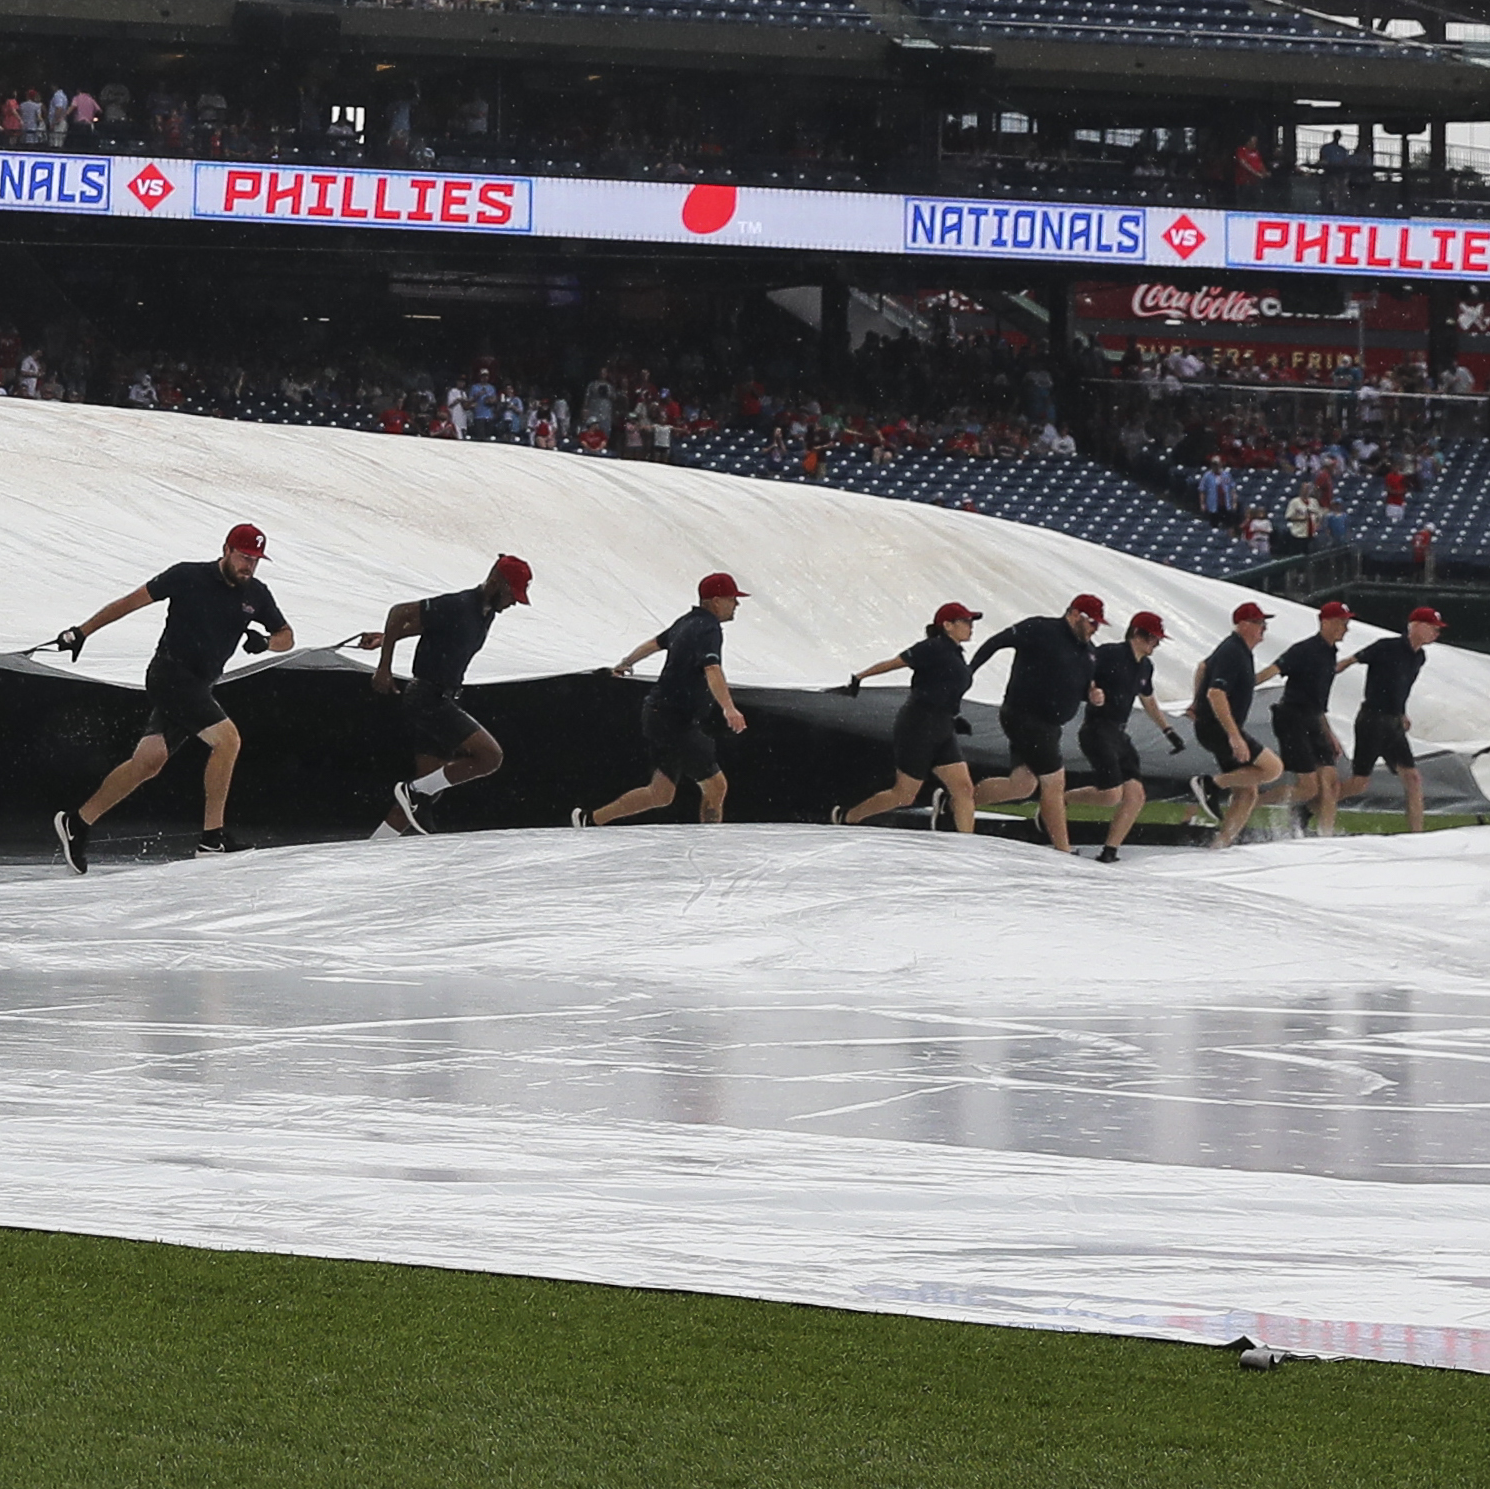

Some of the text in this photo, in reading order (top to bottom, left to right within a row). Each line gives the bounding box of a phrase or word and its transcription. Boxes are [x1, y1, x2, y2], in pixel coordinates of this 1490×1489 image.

[137, 178, 164, 196] VS
[223, 170, 514, 225] PHILLIES
[911, 204, 1141, 254] NATIONALS
[1170, 228, 1198, 246] VS
